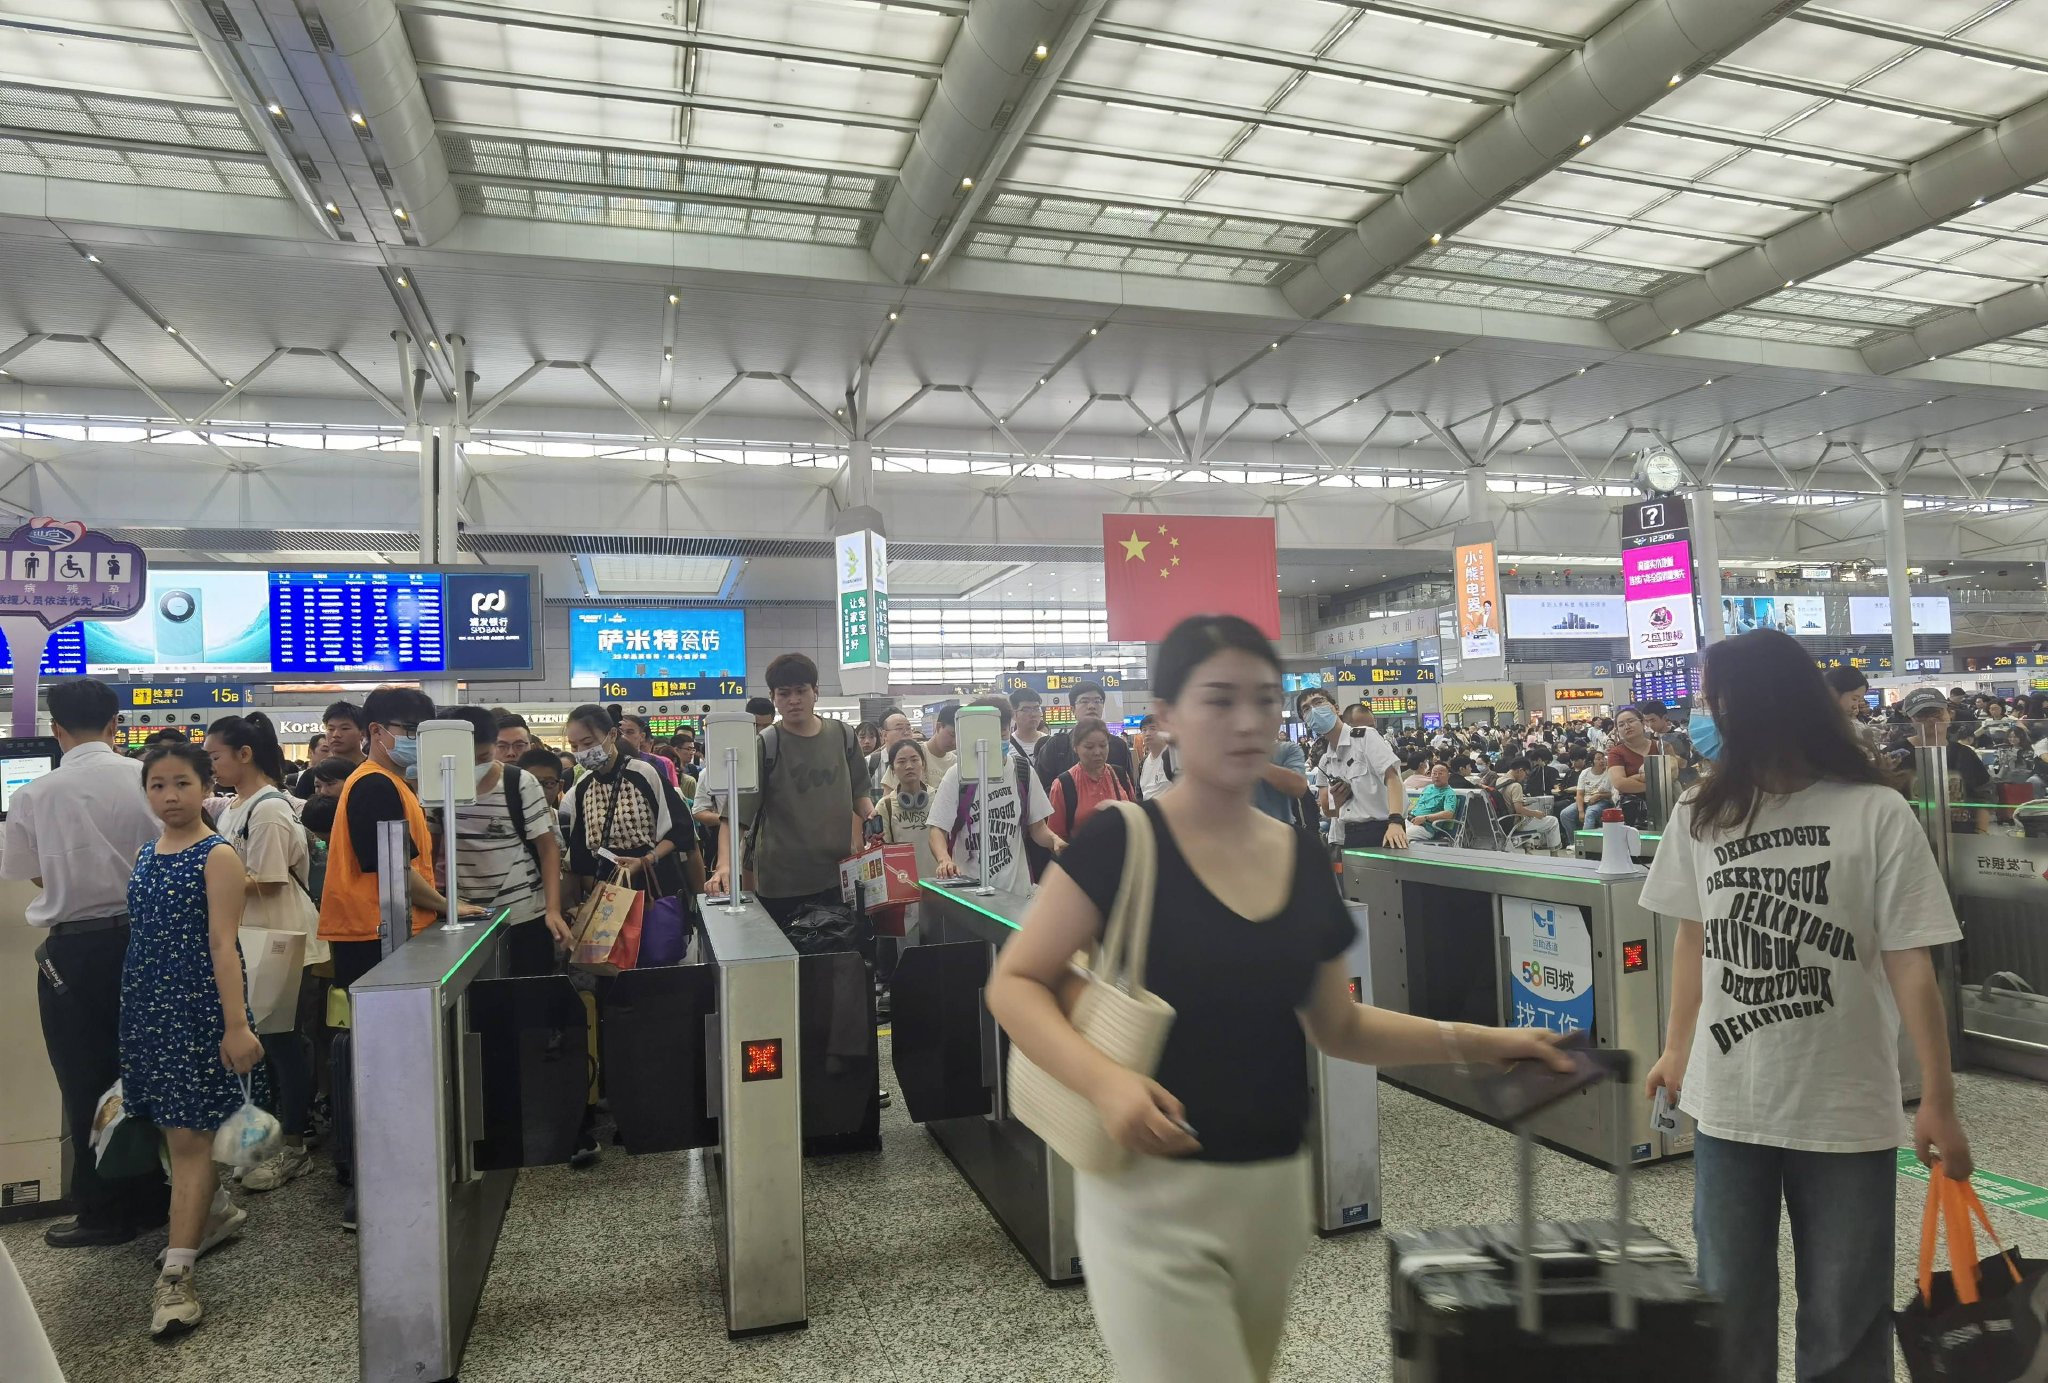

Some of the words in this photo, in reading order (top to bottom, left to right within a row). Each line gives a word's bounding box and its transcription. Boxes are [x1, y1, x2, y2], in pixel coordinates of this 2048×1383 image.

[24, 584, 36, 594] 病
[66, 584, 79, 594] 残
[108, 584, 120, 594] 孕
[1464, 551, 1481, 613] 小熊电器
[598, 629, 720, 651] 萨米特瓷砖
[1641, 630, 1683, 643] 久盛地板
[1101, 675, 1120, 687] 19B
[1338, 671, 1356, 682] 20B
[1417, 669, 1435, 680] 21B
[602, 683, 628, 697] 16B
[719, 682, 743, 695] 17B
[1007, 677, 1027, 689] 18B
[153, 688, 184, 698] 检票口
[212, 688, 239, 703] 15B
[1713, 826, 1830, 866] DEKKRYDGUK
[1706, 860, 1831, 905] DEKKRYDGUK
[1728, 891, 1857, 961] DEKKRYDGUK
[1702, 919, 1800, 971] EKKRYDGUK
[1522, 961, 1575, 994] 58同城
[1720, 966, 1835, 1007] DEKKRYDGUK
[1709, 1000, 1826, 1055] DEKKRYDGUK
